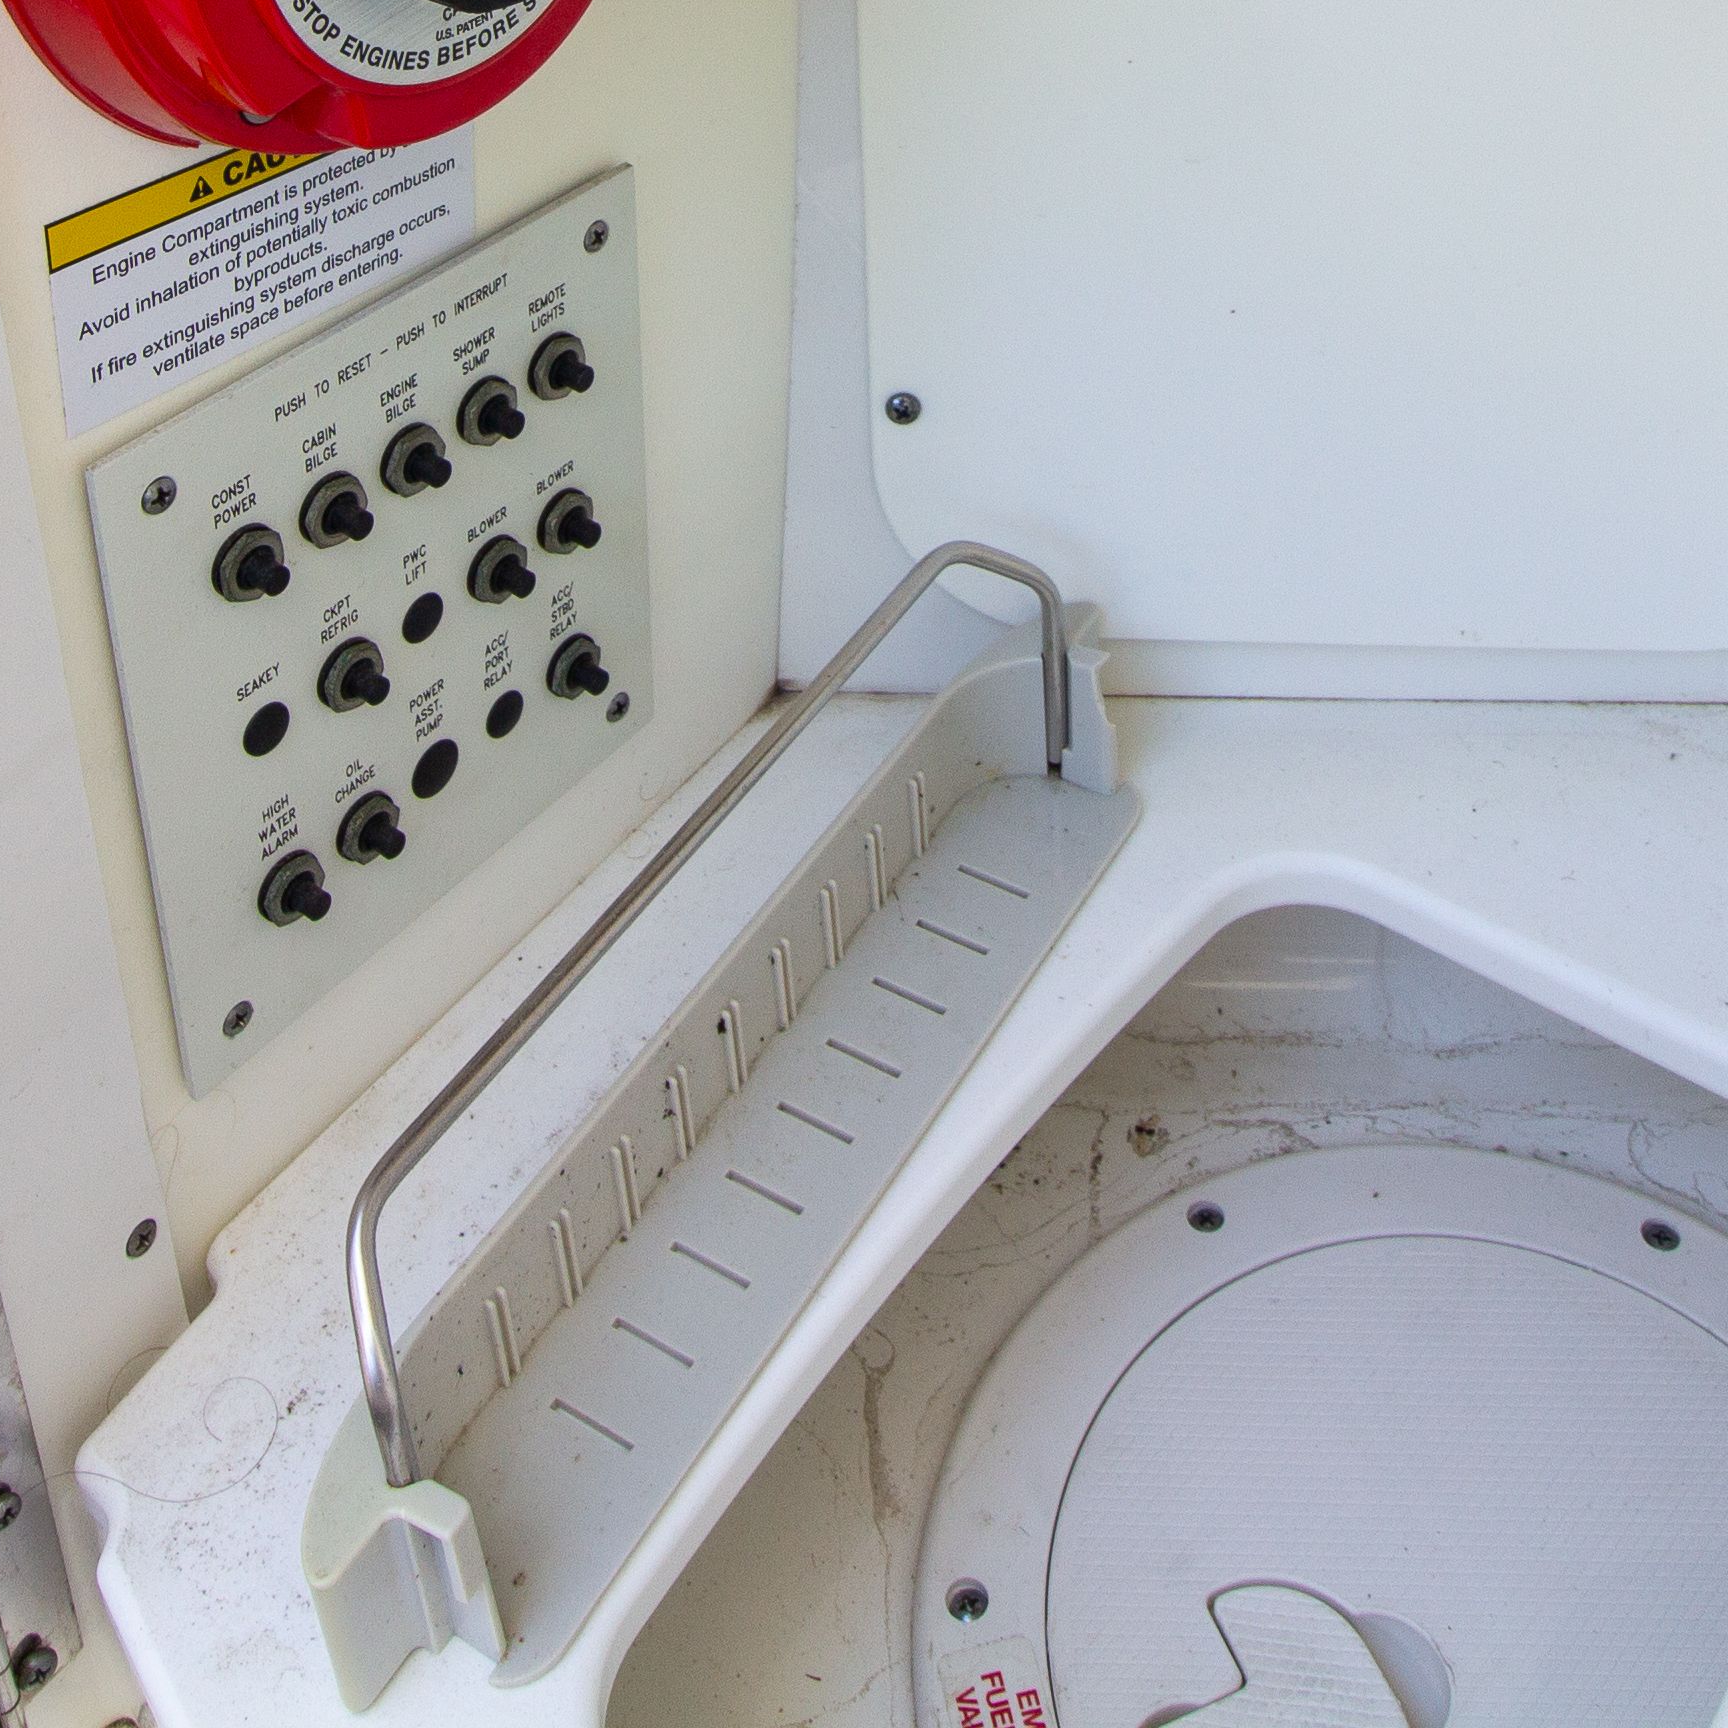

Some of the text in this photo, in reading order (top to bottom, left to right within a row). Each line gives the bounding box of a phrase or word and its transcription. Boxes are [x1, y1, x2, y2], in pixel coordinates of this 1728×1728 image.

[340, 34, 430, 71] ENGINES
[437, 8, 519, 66] BEFORE
[435, 28, 454, 41] U.S.
[457, 11, 494, 35] PATENT
[92, 246, 156, 285] Engine
[161, 191, 280, 252] Compartment
[284, 185, 298, 201] is
[302, 148, 375, 192] protected
[380, 146, 396, 159] by
[188, 179, 364, 267] extinguishing system.
[78, 158, 455, 341] Avoid inhalation of potentially toxic combustion
[233, 240, 328, 295] byproducts.
[91, 203, 450, 384] If fire extinguishing system discharge occurs,
[527, 283, 566, 316] REMOTE
[152, 247, 404, 378] ventilate space before entering.
[531, 303, 565, 333] LIGHTS
[274, 273, 508, 421] PUSH TO RESET PUSH TO INTERRUPT
[452, 326, 496, 363] SHOWER
[462, 348, 490, 376] SUMP
[379, 373, 418, 408] ENGINE
[386, 393, 417, 424] BILGE
[302, 424, 337, 454] CABIN
[305, 442, 338, 473] BILGE
[211, 475, 252, 510] CONST
[536, 460, 574, 496] BLOWER
[213, 493, 257, 529] POWER
[467, 506, 508, 543] BLOWER
[402, 544, 427, 569] PWC
[404, 561, 427, 586] LIFT
[323, 594, 352, 623] CKPT
[550, 611, 578, 640] RELAY
[551, 598, 574, 624] STBD
[320, 609, 359, 644] REFRIG
[483, 660, 513, 691] RELAY
[484, 646, 509, 673] PORT
[236, 661, 281, 702] SEAKEY
[409, 678, 445, 714] POWER
[414, 699, 443, 727] ASST.
[416, 714, 443, 742] PUMP
[334, 765, 376, 805] CHANGE
[345, 759, 363, 778] OIL
[257, 808, 296, 844] WATER
[261, 794, 290, 823] HIGH
[261, 825, 299, 861] ALARM
